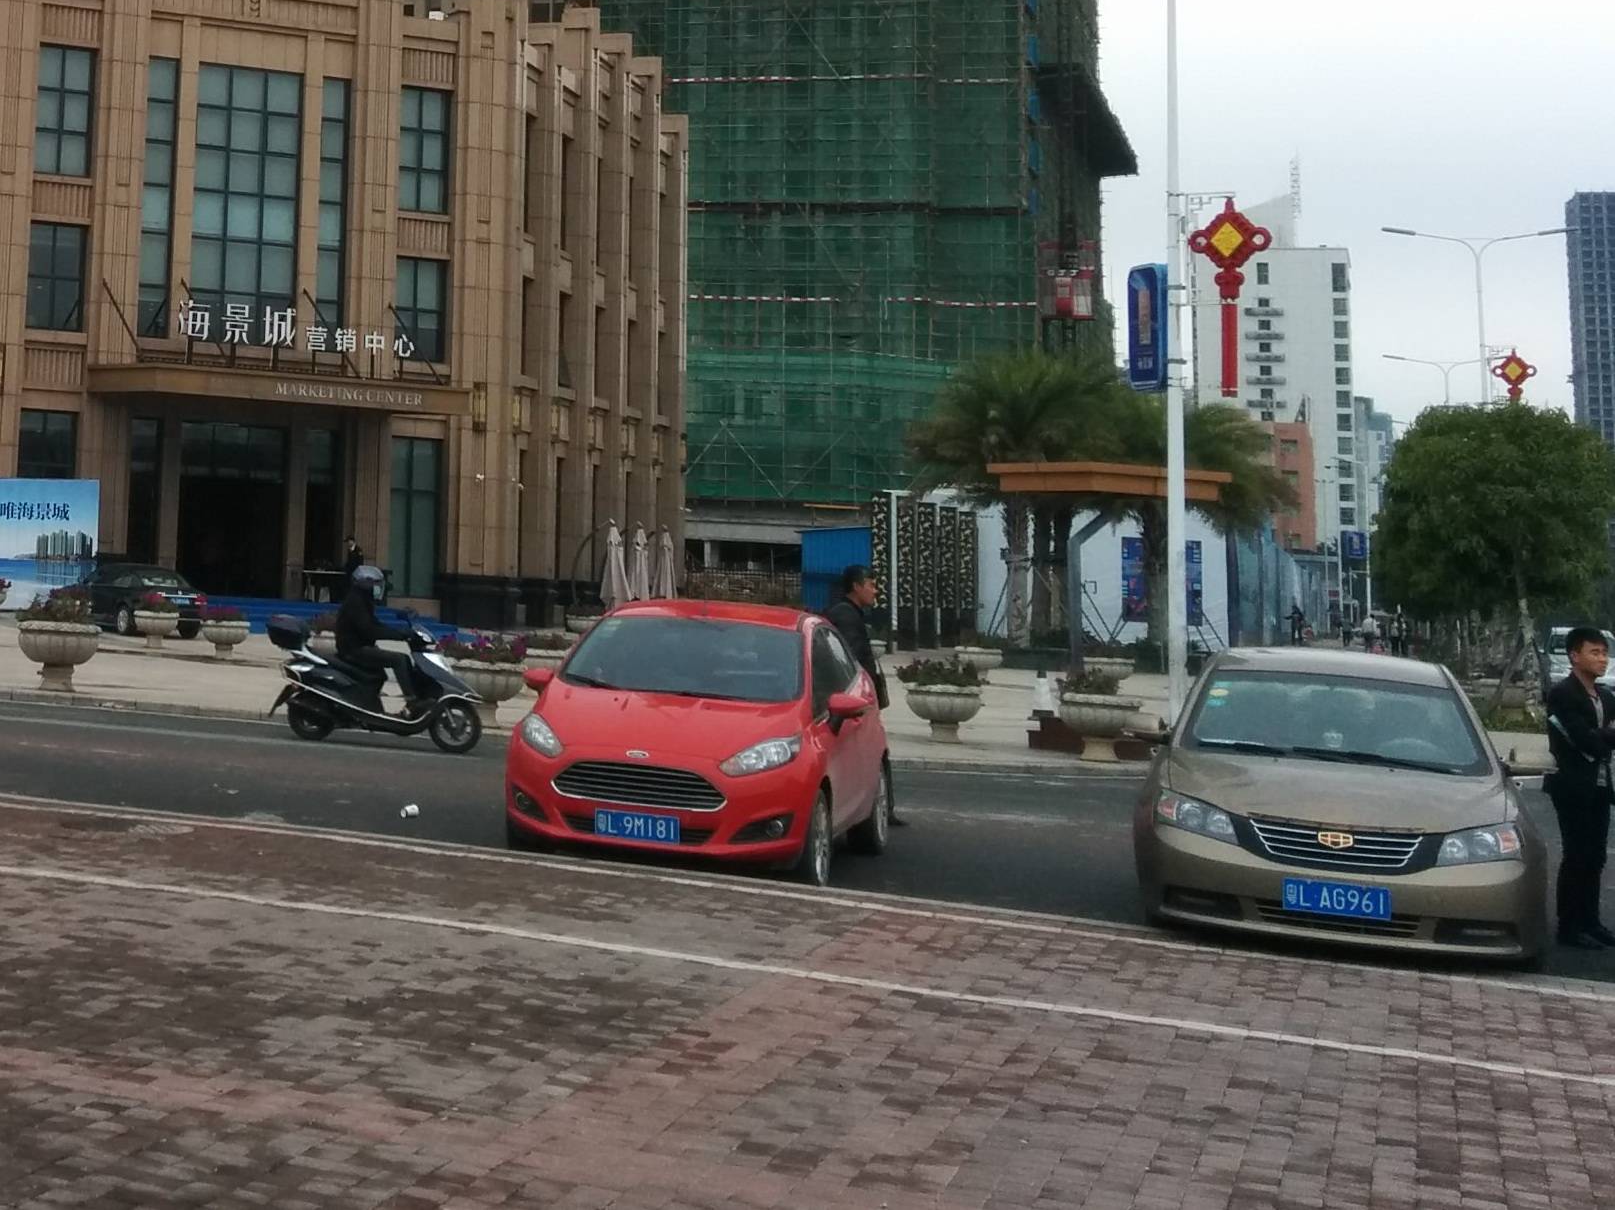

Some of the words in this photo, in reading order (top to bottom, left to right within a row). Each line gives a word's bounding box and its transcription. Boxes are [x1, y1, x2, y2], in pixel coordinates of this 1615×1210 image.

[178, 299, 297, 348] 海景城
[306, 325, 415, 358] 营销中心
[275, 382, 363, 401] MARKETING
[367, 389, 422, 405] CENTER
[0, 501, 70, 521] 唯海景城
